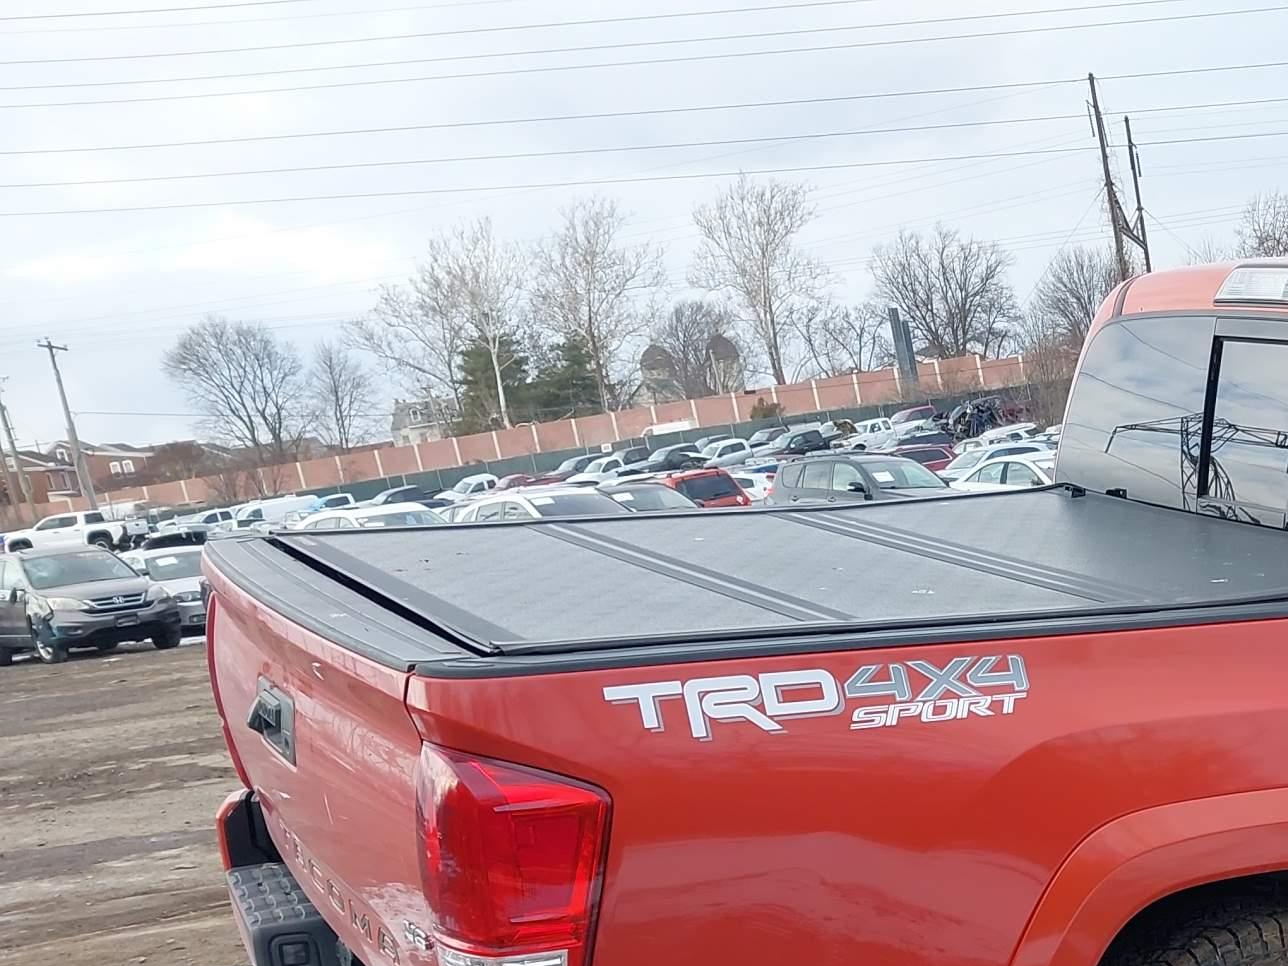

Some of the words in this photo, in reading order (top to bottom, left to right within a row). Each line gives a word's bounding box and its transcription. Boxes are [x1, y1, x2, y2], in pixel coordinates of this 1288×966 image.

[603, 668, 844, 741] TRD
[849, 692, 1028, 730] SPORT
[279, 818, 401, 966] TACOMA
